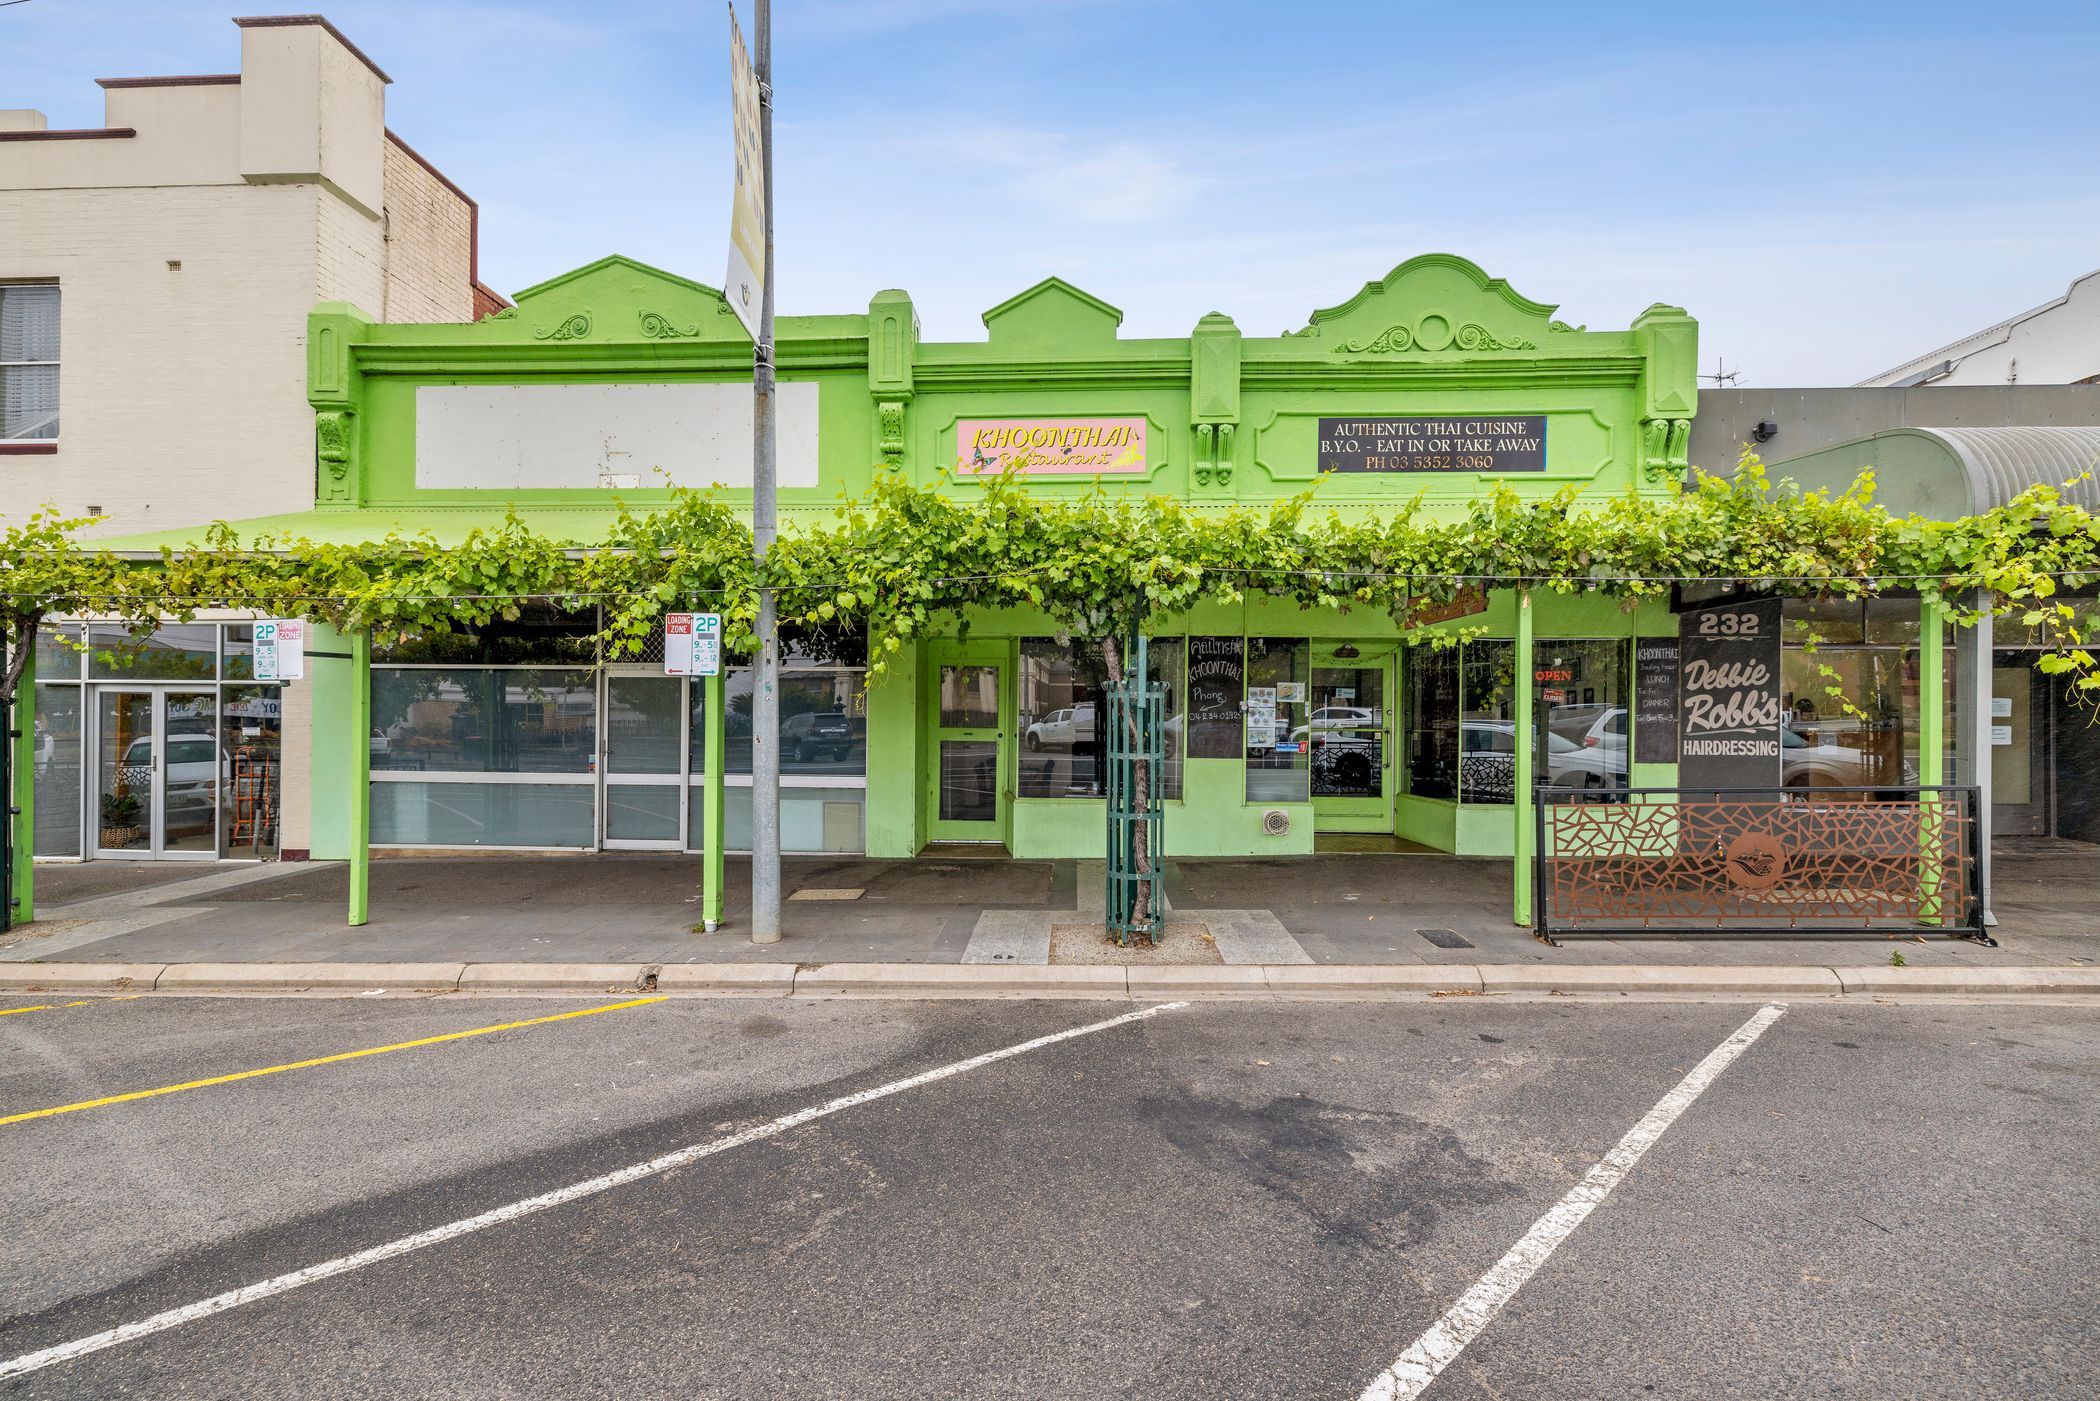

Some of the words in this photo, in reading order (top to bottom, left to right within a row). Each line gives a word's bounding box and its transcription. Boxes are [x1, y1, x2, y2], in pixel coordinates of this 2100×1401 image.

[1334, 422, 1421, 436] AUTHENTIC
[1424, 422, 1461, 435] THAI
[1465, 421, 1527, 435] CUISINE
[972, 425, 1133, 449] KHOONTHAI
[1321, 440, 1361, 453] B.Y.O.
[1377, 440, 1404, 452] EAT
[1408, 440, 1425, 452] IN
[1428, 439, 1451, 452] OR
[1454, 439, 1492, 452] TAKE
[1495, 438, 1541, 451] AWAY
[1366, 456, 1386, 469] PH
[1390, 456, 1409, 468] 03
[1413, 456, 1451, 468] 5352
[1455, 455, 1493, 468] 3060
[667, 616, 691, 625] LOADING
[696, 617, 717, 631] 2P
[1700, 613, 1759, 634] 232
[256, 625, 275, 639] 2P
[279, 631, 301, 639] ZONE
[670, 625, 688, 634] ZONE
[1637, 647, 1679, 660] KHOONTHAI
[1188, 661, 1243, 683] KHOONTHAI
[1535, 671, 1572, 681] OPEN
[1646, 675, 1670, 683] LUNCH
[1684, 658, 1770, 690] Debbie
[1193, 687, 1223, 703] Phone
[1642, 699, 1670, 708] DINNER
[1684, 689, 1779, 732] Robb's
[1683, 740, 1779, 757] HAIRDRESSING
